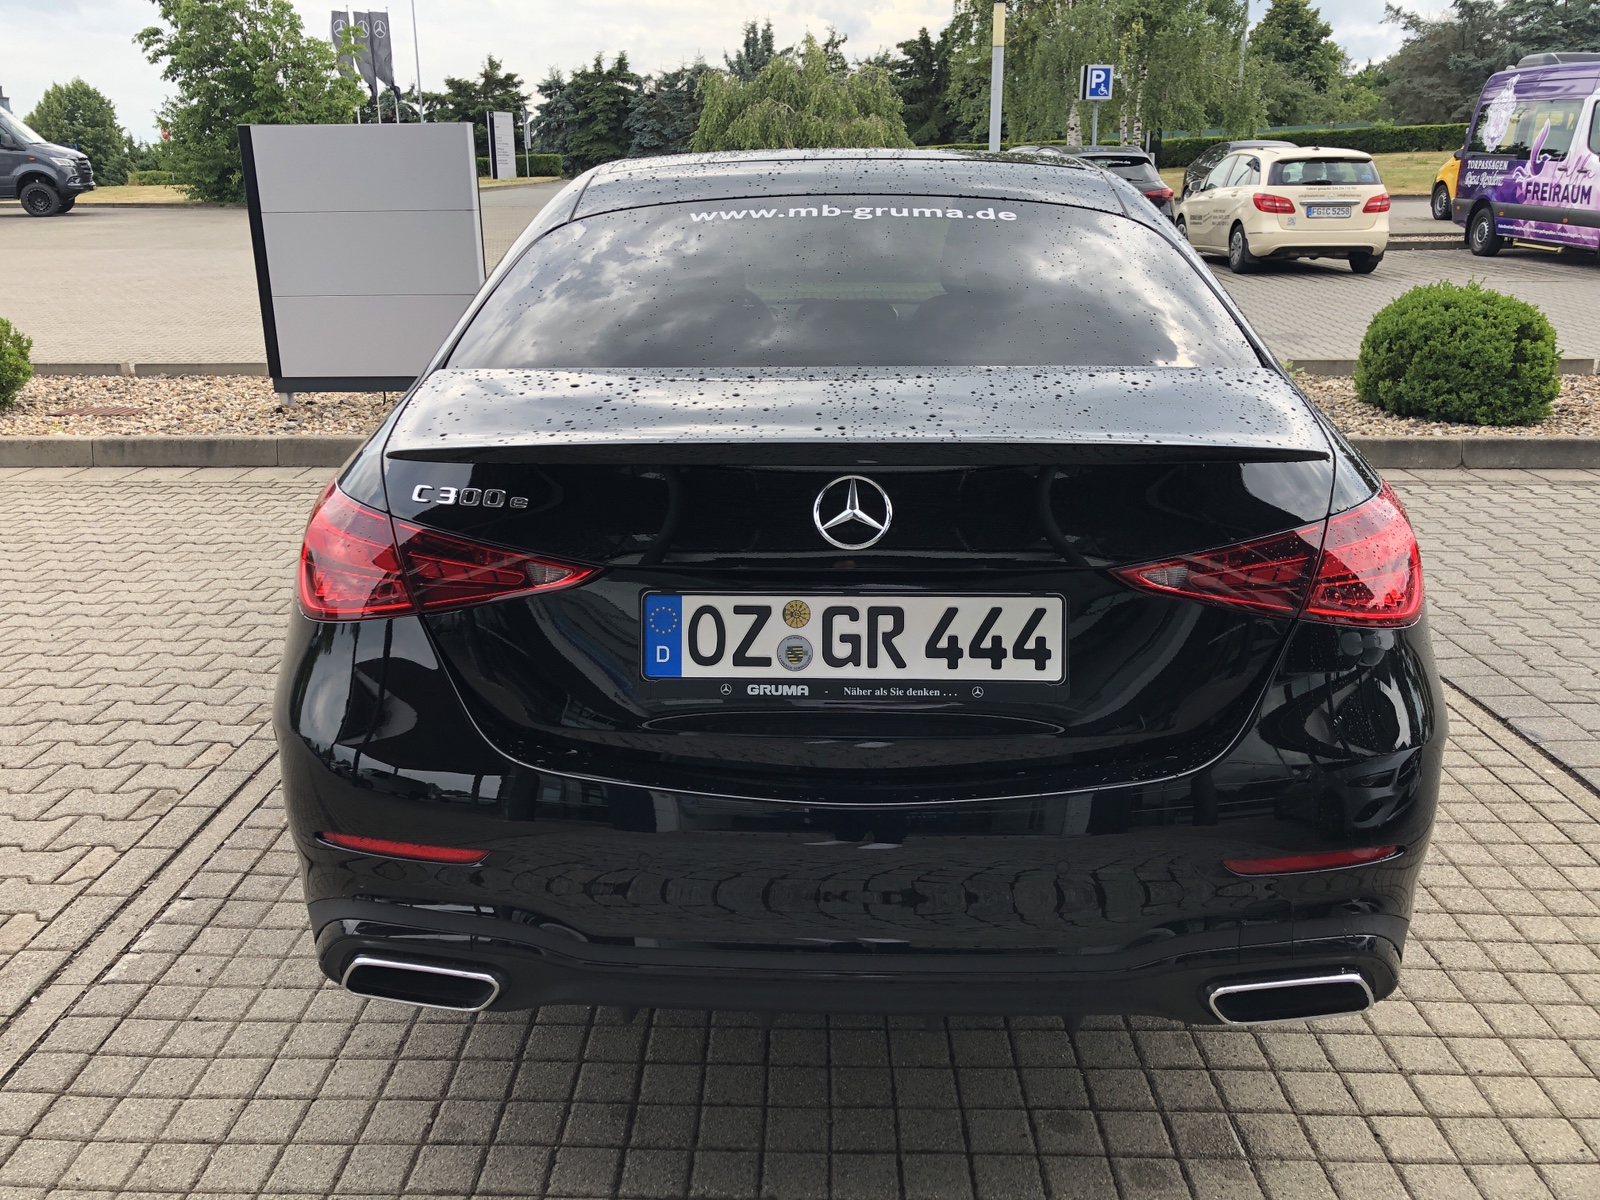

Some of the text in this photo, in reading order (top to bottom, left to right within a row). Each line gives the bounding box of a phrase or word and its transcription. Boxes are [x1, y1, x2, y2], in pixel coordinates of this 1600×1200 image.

[1090, 69, 1106, 89] P
[1467, 160, 1509, 170] TORPASSAGEN
[1524, 182, 1592, 204] FREIRAUM
[689, 204, 1018, 221] www.mb-gruma.de
[1312, 207, 1350, 216] FG C 5258
[688, 604, 1052, 671] OZ GR 444
[656, 645, 670, 663] D
[746, 684, 809, 696] GRUMA
[843, 687, 873, 696] Näher
[874, 687, 888, 696] als
[889, 687, 904, 696] Sie
[906, 687, 940, 696] denken
